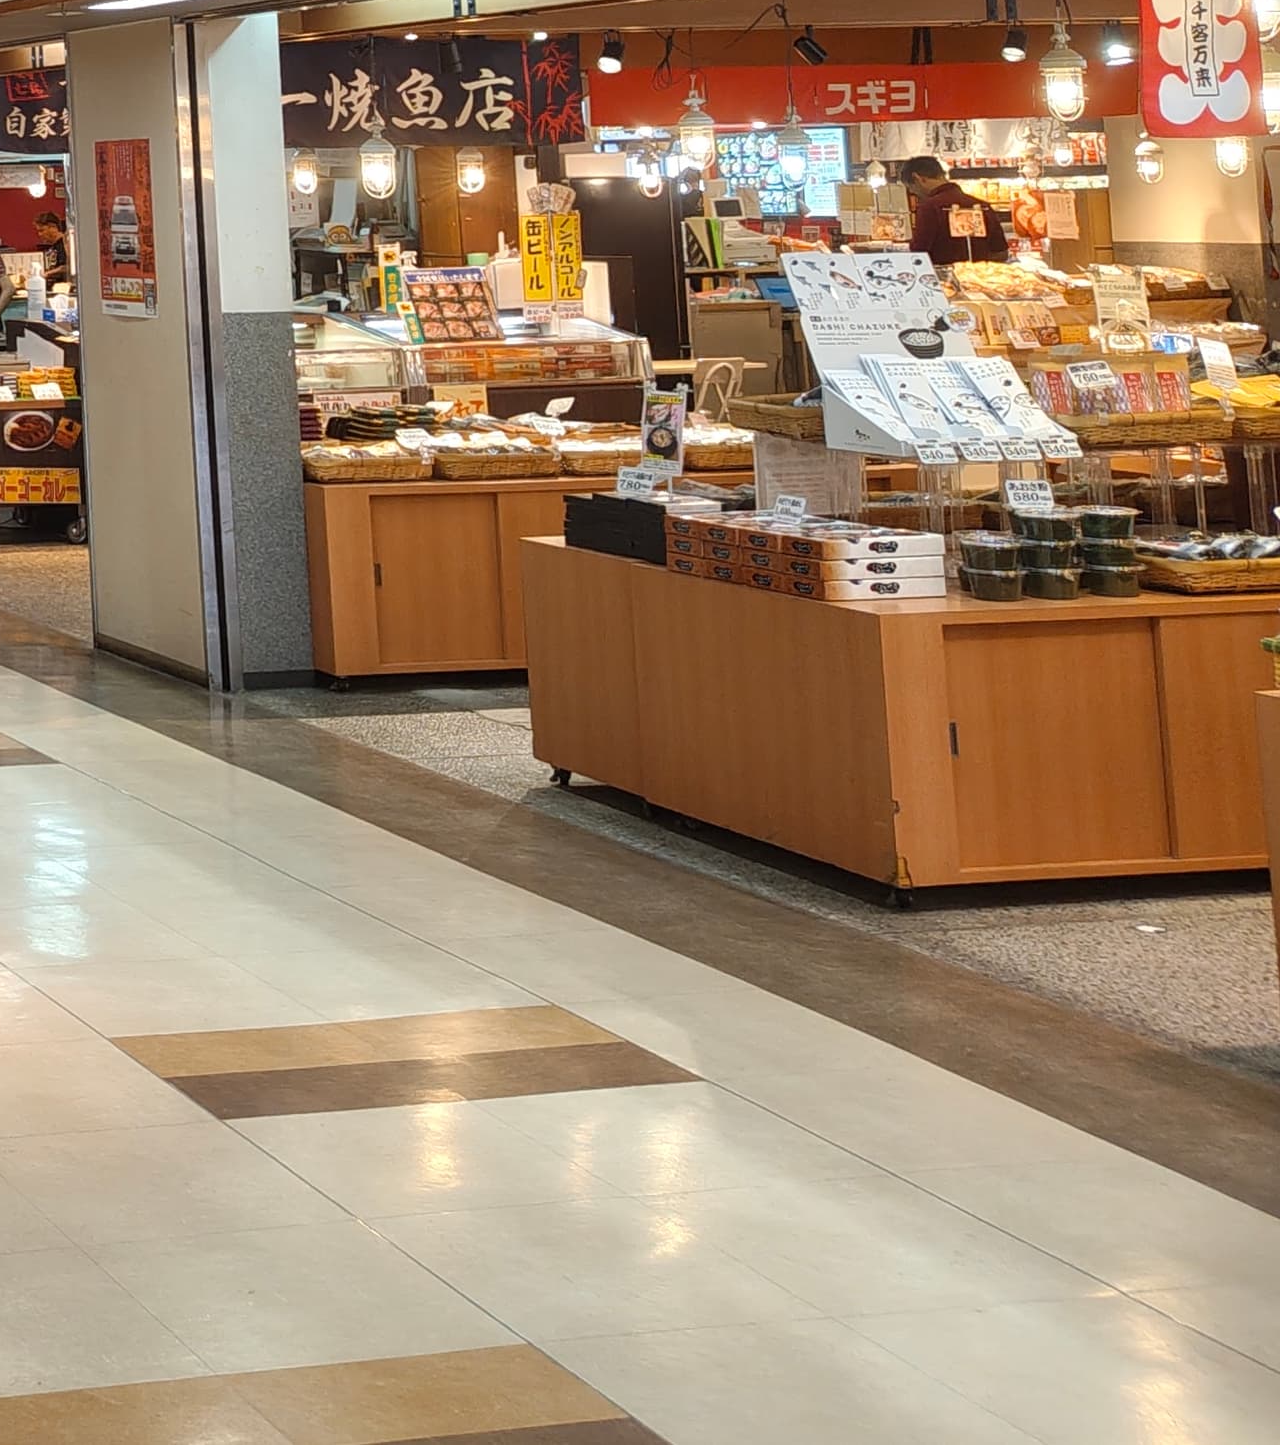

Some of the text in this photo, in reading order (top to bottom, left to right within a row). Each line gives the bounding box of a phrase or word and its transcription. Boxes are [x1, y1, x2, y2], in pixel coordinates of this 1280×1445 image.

[1191, 1, 1212, 88] 千客万来
[826, 80, 916, 116] スギヨ
[526, 219, 544, 290] 缶ビール
[558, 218, 576, 297] ノンアルコール
[1074, 373, 1098, 387] 760
[920, 449, 943, 460] 540
[963, 447, 986, 458] 540
[1004, 446, 1028, 456] 540
[1046, 445, 1069, 455] 540
[620, 479, 640, 490] 780
[1013, 492, 1038, 502] 580
